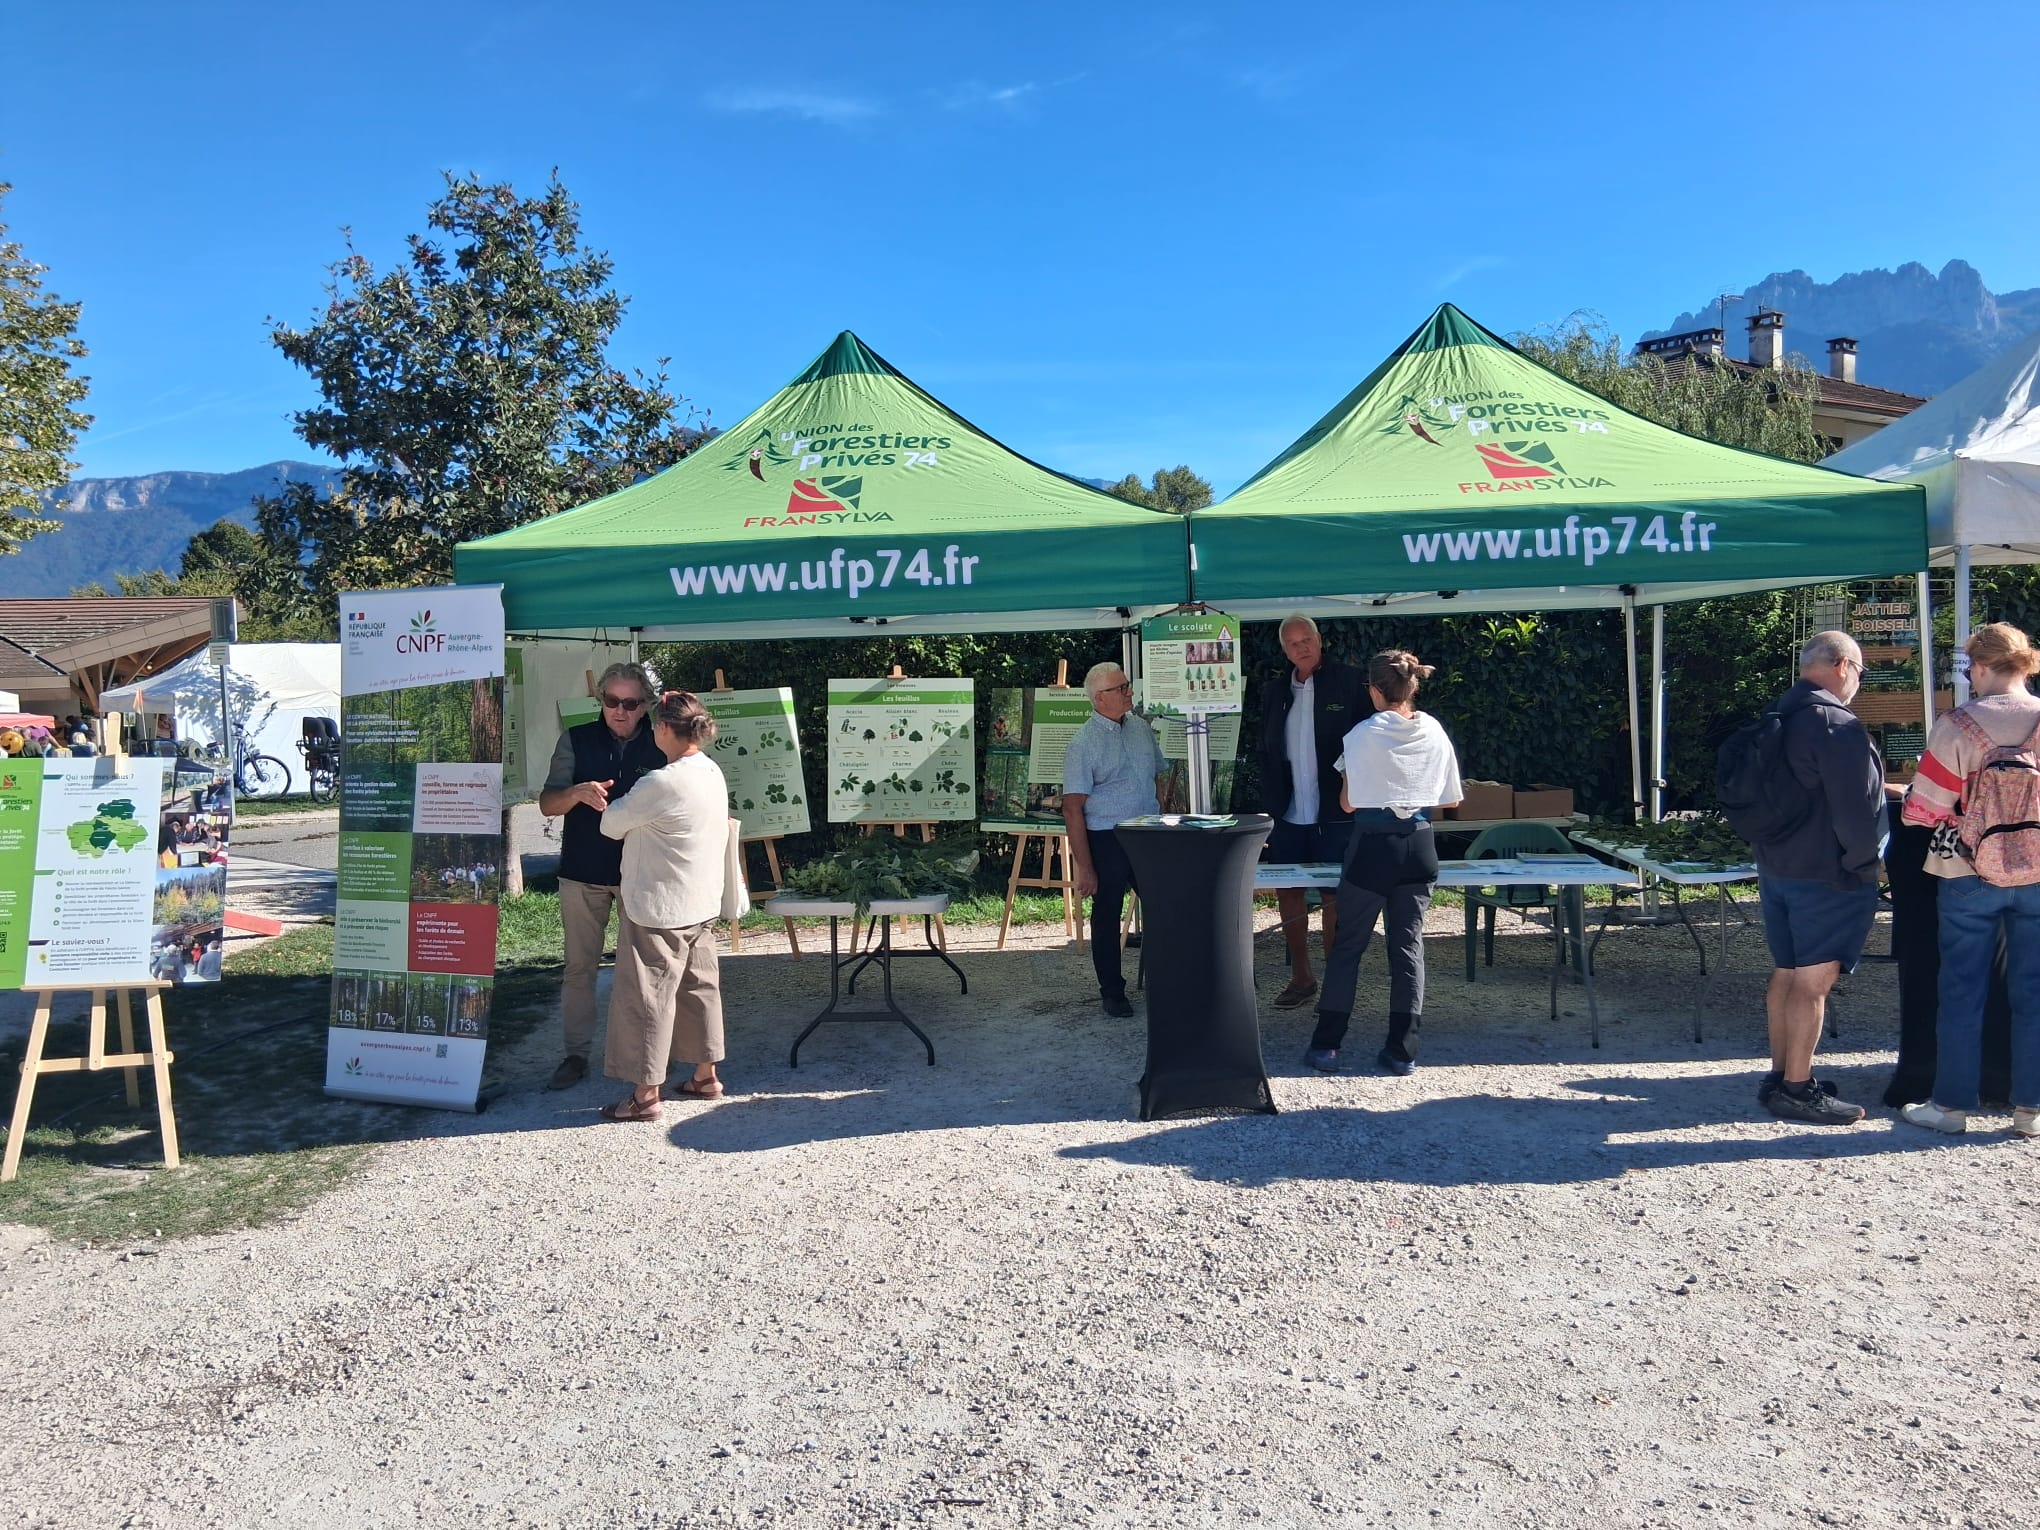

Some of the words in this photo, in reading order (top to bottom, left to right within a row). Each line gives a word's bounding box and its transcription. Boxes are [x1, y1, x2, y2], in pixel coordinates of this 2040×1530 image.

[1498, 390, 1524, 399] des
[1448, 401, 1610, 422] Forestiers
[848, 423, 874, 432] des
[1467, 417, 1569, 436] Privés
[1570, 420, 1609, 434] 74
[791, 432, 952, 456] Forestiers
[799, 450, 896, 471] Privés
[903, 451, 937, 467] 74
[1458, 477, 1616, 494] FRANSYLVA
[743, 511, 895, 528] FRANSYLVA
[1402, 511, 1717, 566] www.ufp74.fr
[669, 544, 980, 599] www.ufp74.fr
[1852, 603, 1911, 615] JATTIER
[349, 622, 386, 630] RÉPUBLIQUE
[1168, 623, 1180, 631] Le
[1181, 622, 1213, 632] scolyte
[1852, 619, 1919, 632] BOISSELI
[349, 631, 384, 639] FRANÇAISE
[448, 634, 484, 642] Auvergne-
[396, 634, 447, 654] CNPF
[448, 644, 493, 653] Rhône-Alpes
[1049, 709, 1084, 717] Production
[338, 1010, 358, 1023] 18%
[376, 1013, 396, 1025] 17%
[417, 1016, 436, 1029] 15%
[459, 1019, 478, 1032] 13%
